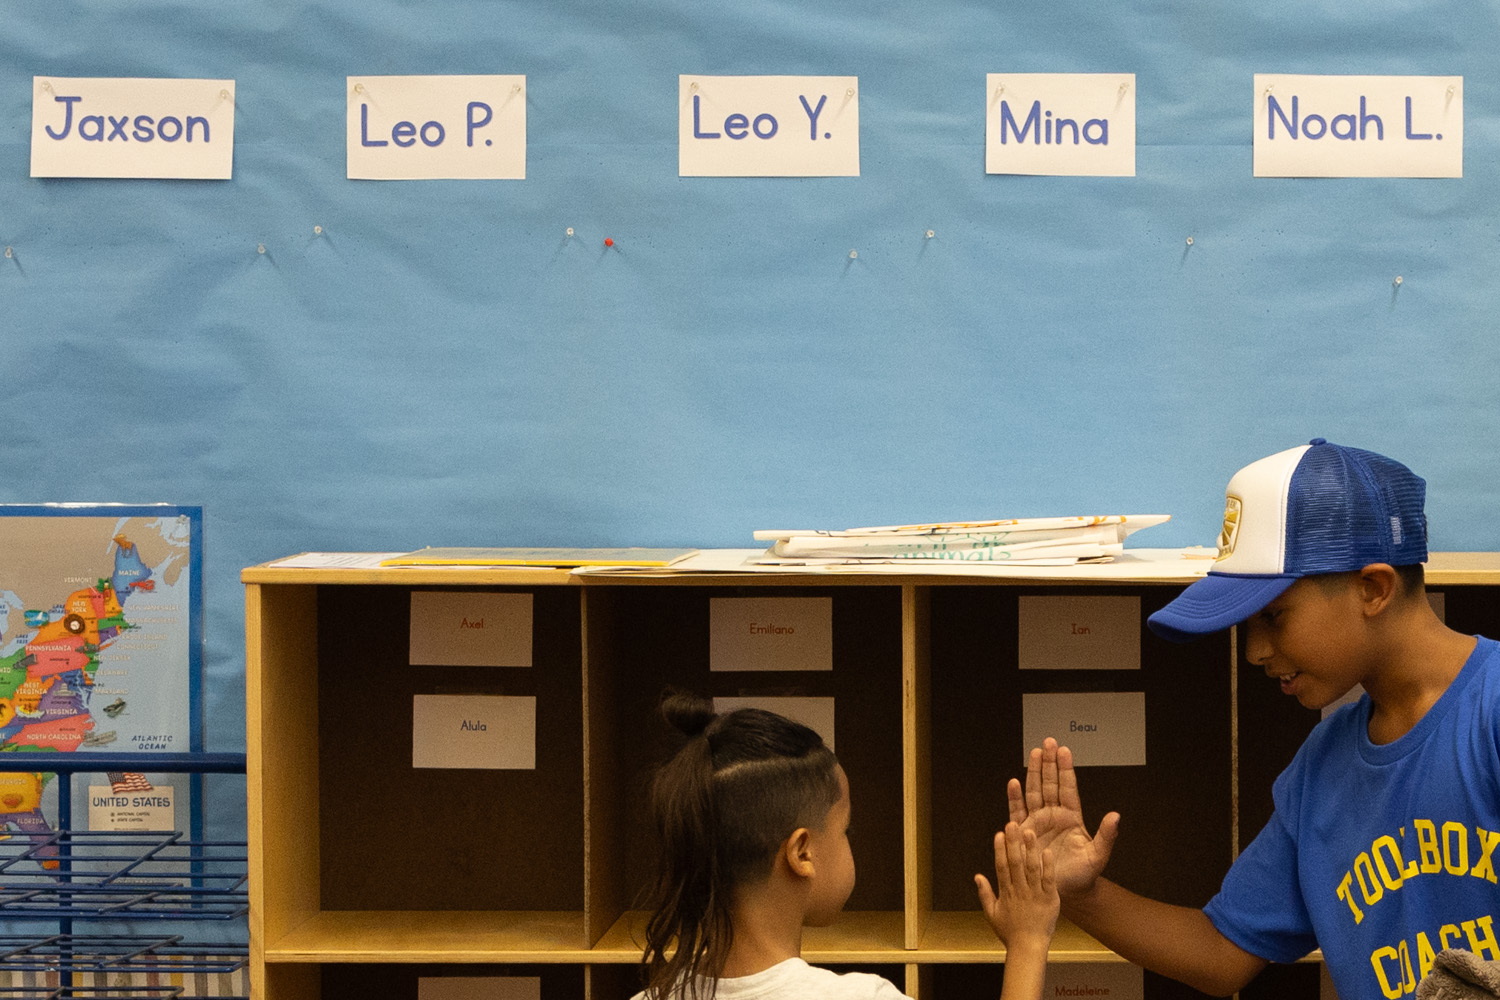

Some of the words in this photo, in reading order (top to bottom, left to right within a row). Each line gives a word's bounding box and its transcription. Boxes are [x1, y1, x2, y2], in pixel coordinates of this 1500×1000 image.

[45, 95, 211, 143] Jaxson
[693, 95, 780, 140] Leo
[799, 95, 832, 140] Y.
[1000, 100, 1110, 145] Mina
[1267, 95, 1385, 141] Noah
[1405, 96, 1444, 141] L.
[361, 103, 446, 148] Leo
[466, 101, 494, 147] P.
[118, 569, 141, 577] MAINE
[460, 617, 484, 629] Axel
[749, 622, 795, 635] Emiliano
[1071, 622, 1091, 635] Ian
[460, 719, 487, 732] Alula
[1069, 719, 1097, 733] Beau
[92, 797, 129, 808] UNITED
[132, 797, 171, 808] STATES
[1055, 984, 1110, 997] Madeleine
